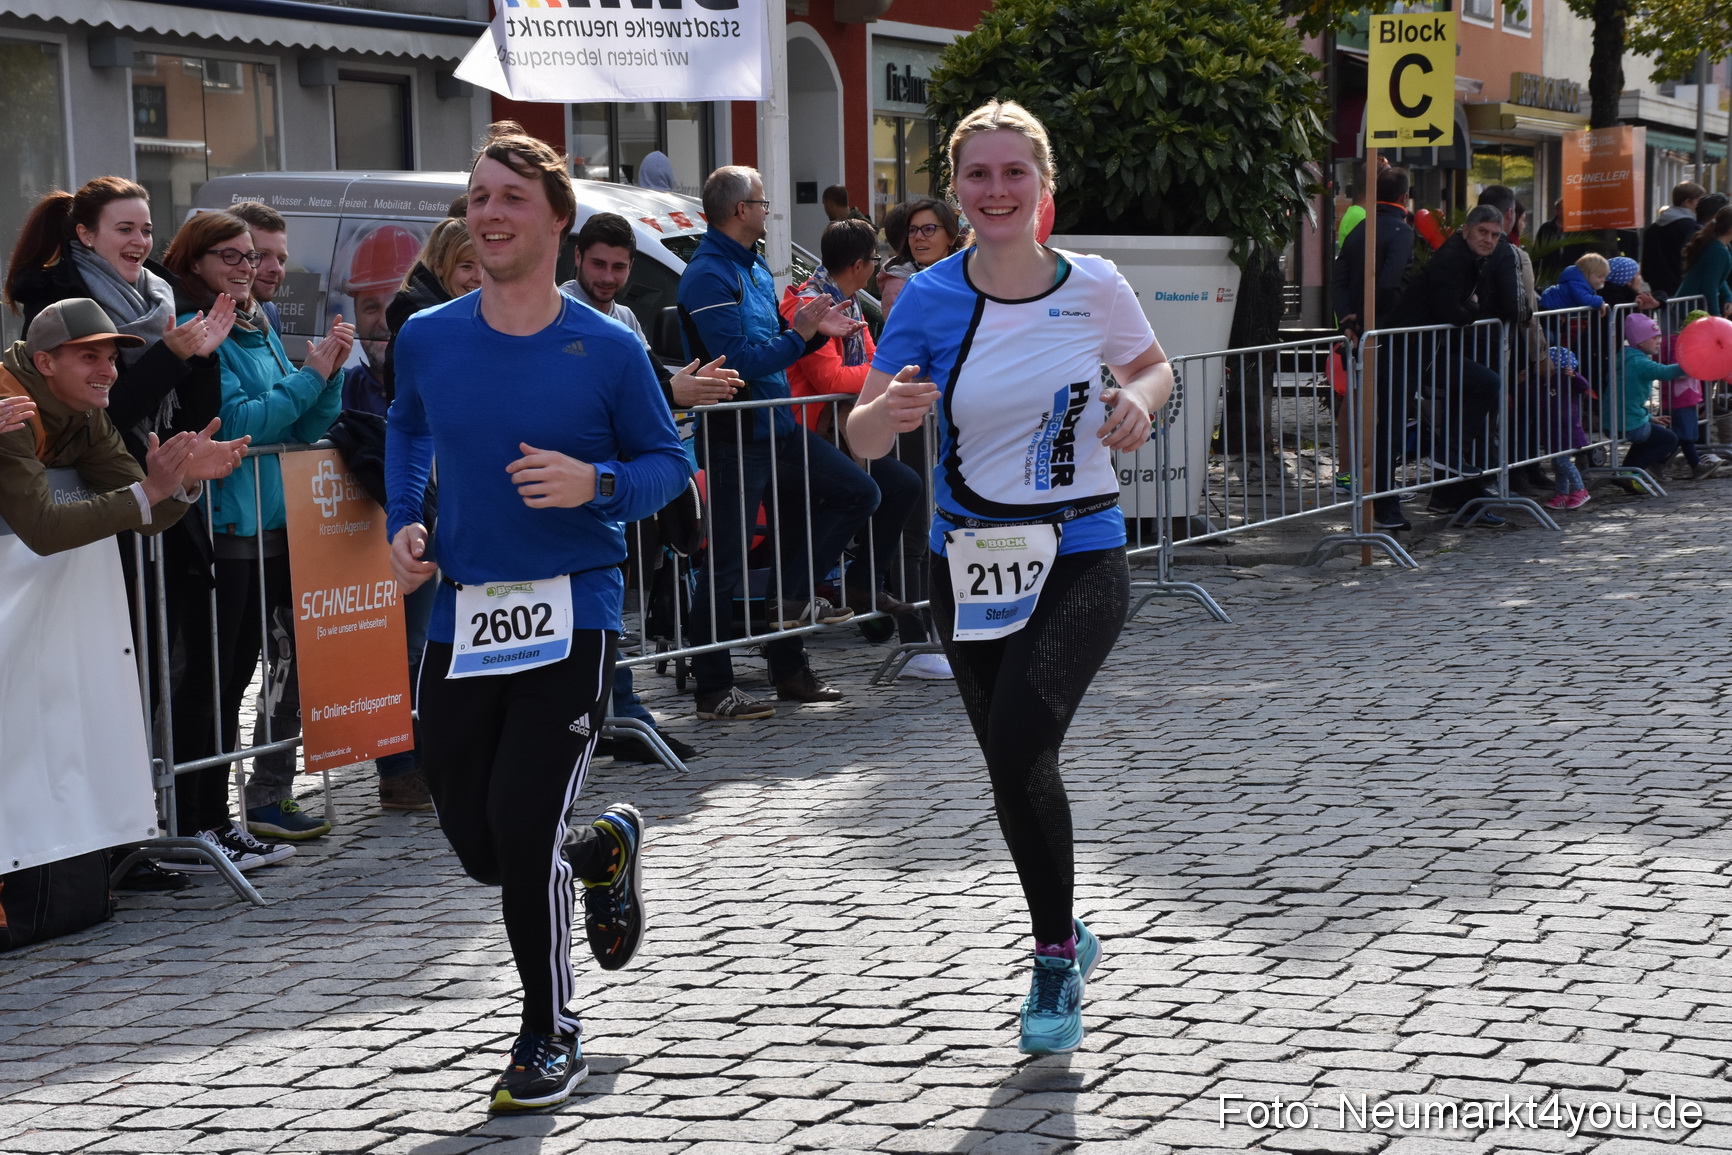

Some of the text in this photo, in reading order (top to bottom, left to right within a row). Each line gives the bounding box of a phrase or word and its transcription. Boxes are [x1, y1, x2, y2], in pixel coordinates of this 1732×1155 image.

[1380, 18, 1447, 43] Block
[1389, 53, 1434, 118] C
[1566, 170, 1631, 185] SCHNELLER!
[272, 195, 302, 206] Wasser
[308, 196, 332, 207] Netze
[338, 196, 367, 208] Freizeit
[373, 198, 412, 210] Mobilität
[1155, 291, 1199, 302] Diakonie
[319, 519, 371, 536] KreativAgentur
[988, 536, 1027, 548] BOCK
[967, 561, 1044, 596] 2113
[300, 580, 398, 621] SCHNELLER!
[316, 615, 388, 639] (So wie unsere Webseiten)
[470, 602, 555, 647] 2602
[482, 649, 540, 665] Sebastian
[311, 693, 403, 722] Ihr Online-Erfolgspartner
